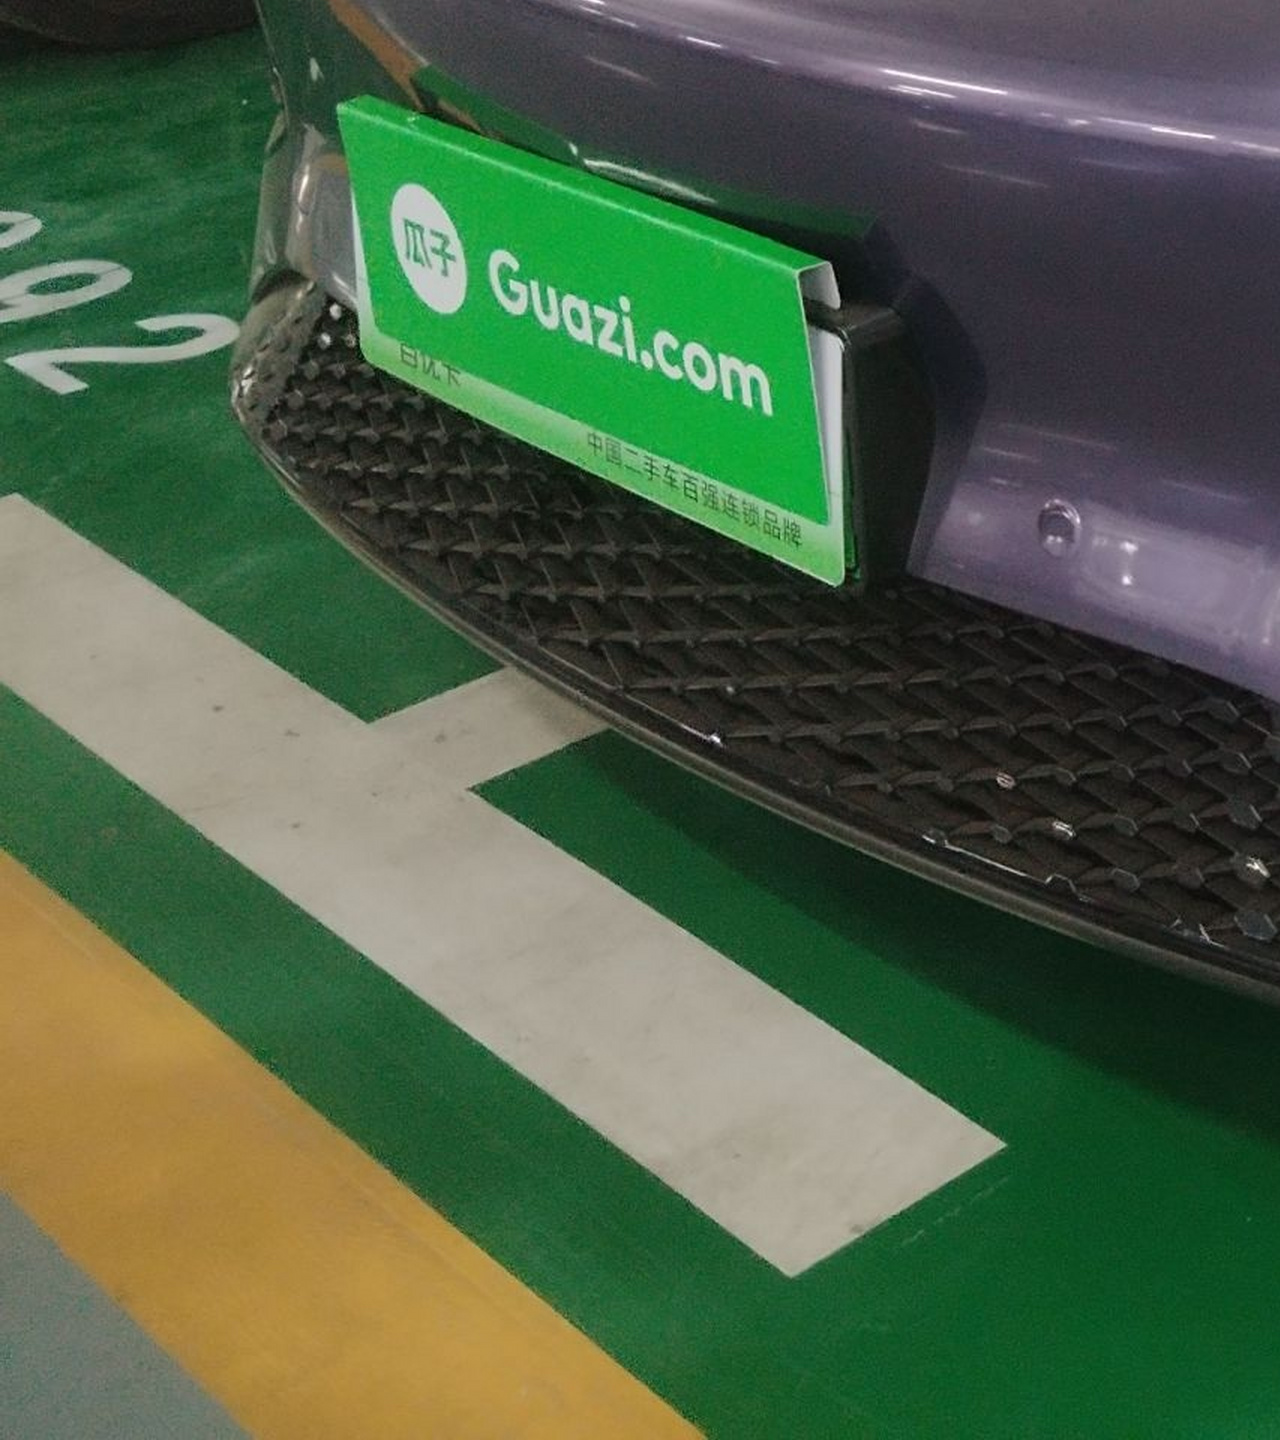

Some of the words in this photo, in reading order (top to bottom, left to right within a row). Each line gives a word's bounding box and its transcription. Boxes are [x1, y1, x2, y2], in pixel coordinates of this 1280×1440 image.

[403, 218, 457, 278] 瓜子
[489, 249, 774, 417] Guazi.com
[587, 431, 803, 549] 中国二手车百强连锁品牌
